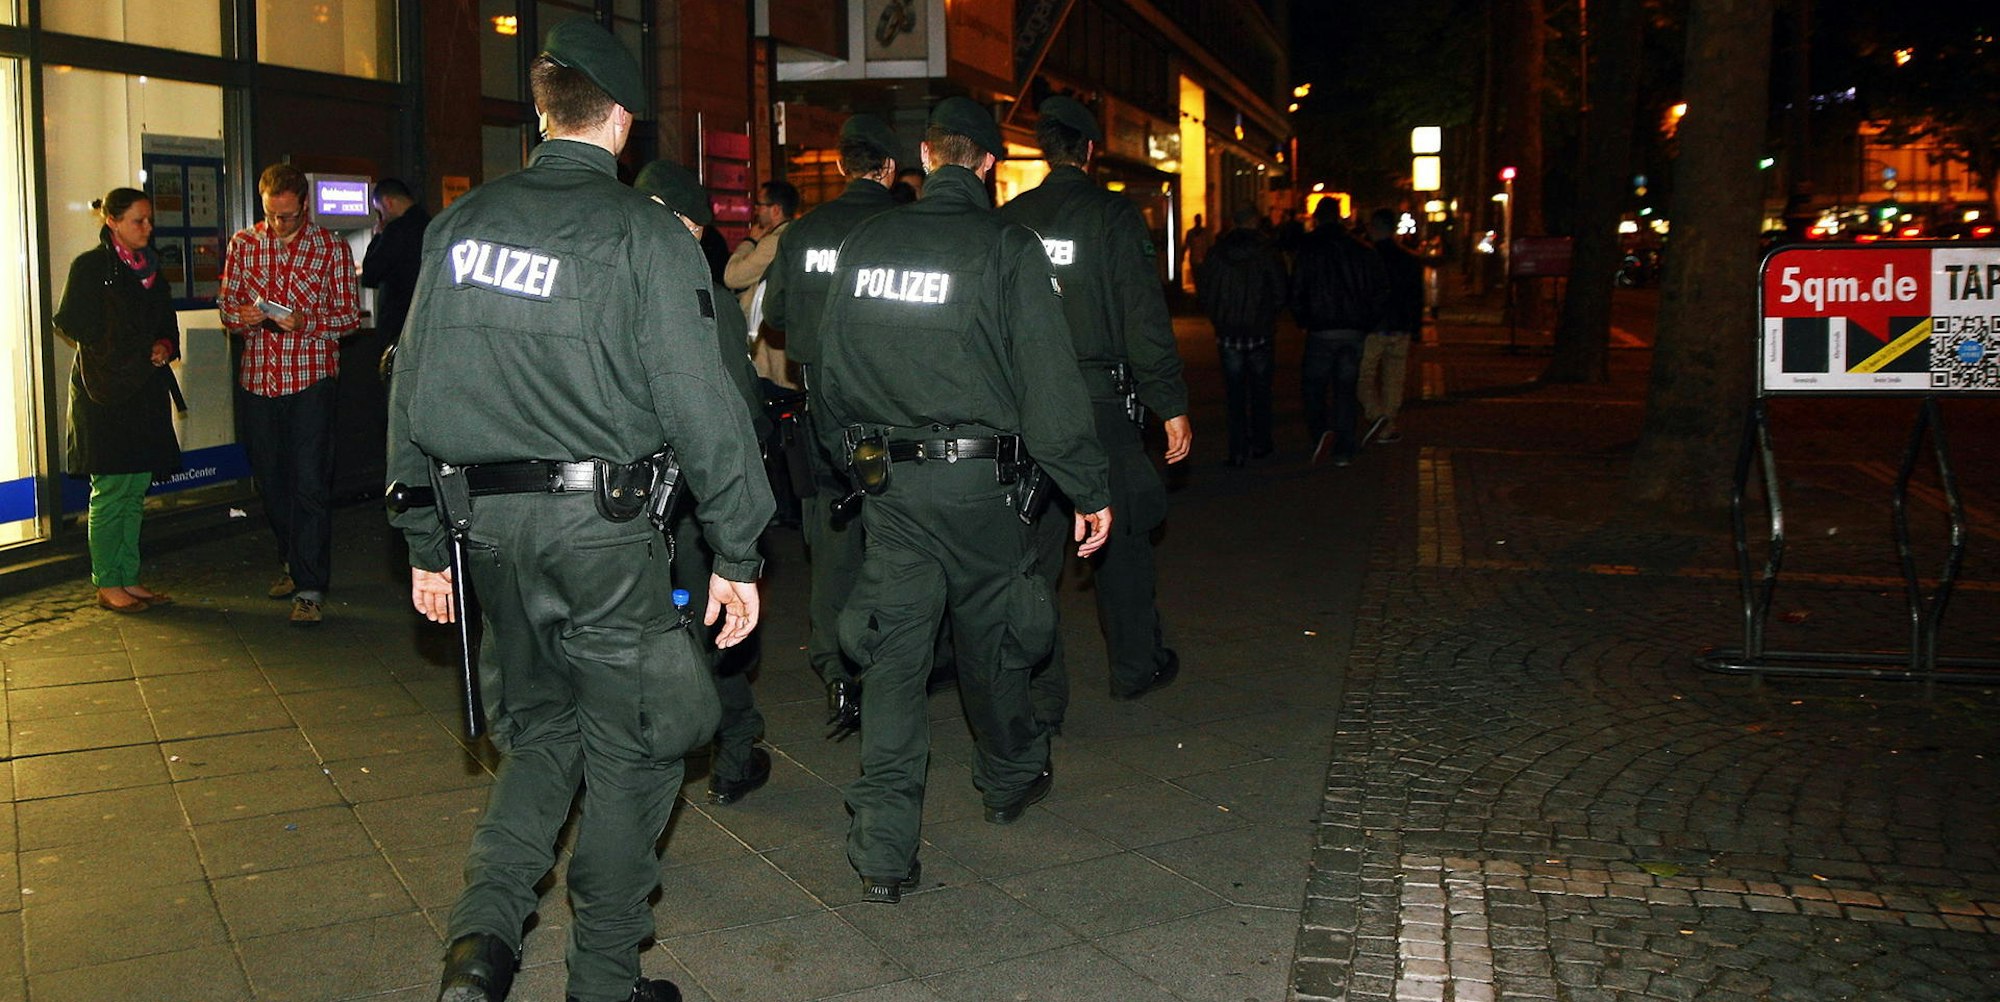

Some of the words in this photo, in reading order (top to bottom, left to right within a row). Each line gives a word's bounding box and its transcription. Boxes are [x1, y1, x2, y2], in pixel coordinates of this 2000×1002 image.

[854, 268, 949, 304] POLIZEI
[1780, 263, 1917, 311] 5qm.de
[1946, 264, 2000, 300] TAP
